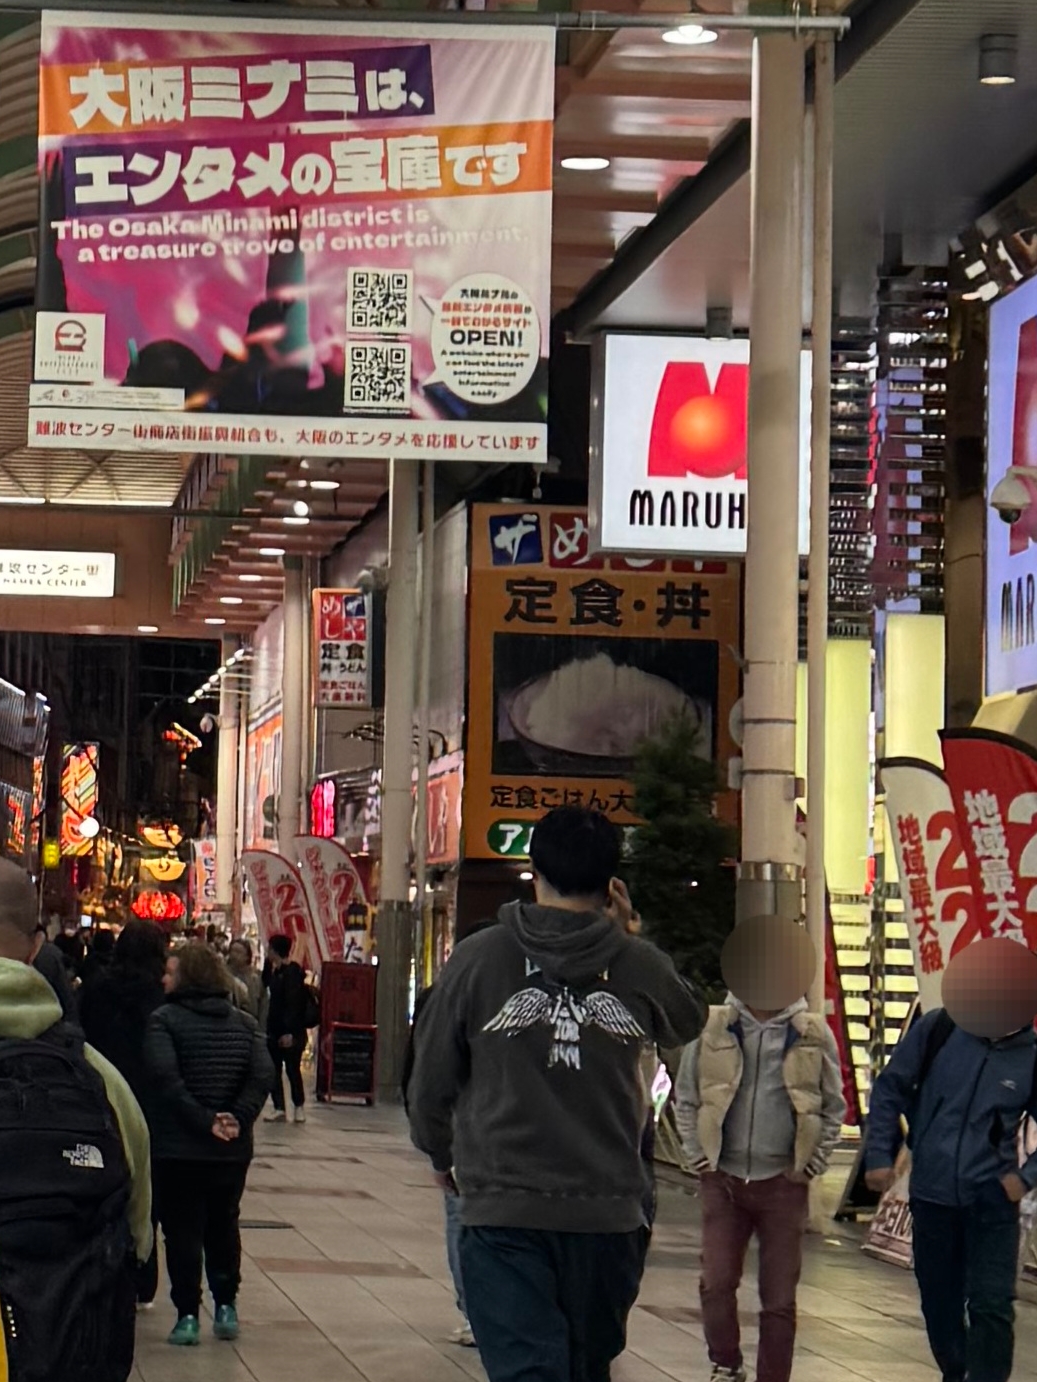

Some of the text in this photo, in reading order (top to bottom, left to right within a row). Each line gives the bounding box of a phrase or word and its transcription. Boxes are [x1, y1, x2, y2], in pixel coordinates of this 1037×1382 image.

[69, 60, 425, 130] 大阪ミナミは、
[74, 135, 527, 206] エンタメの宝庫です
[51, 203, 430, 240] The Osaka Minami district is
[77, 247, 95, 263] a
[98, 242, 217, 262] treasure
[221, 237, 294, 256] trove
[299, 231, 326, 252] of
[450, 329, 523, 348] OPEN!
[504, 577, 711, 630] 定食・丼
[897, 813, 944, 975] 地域最大級
